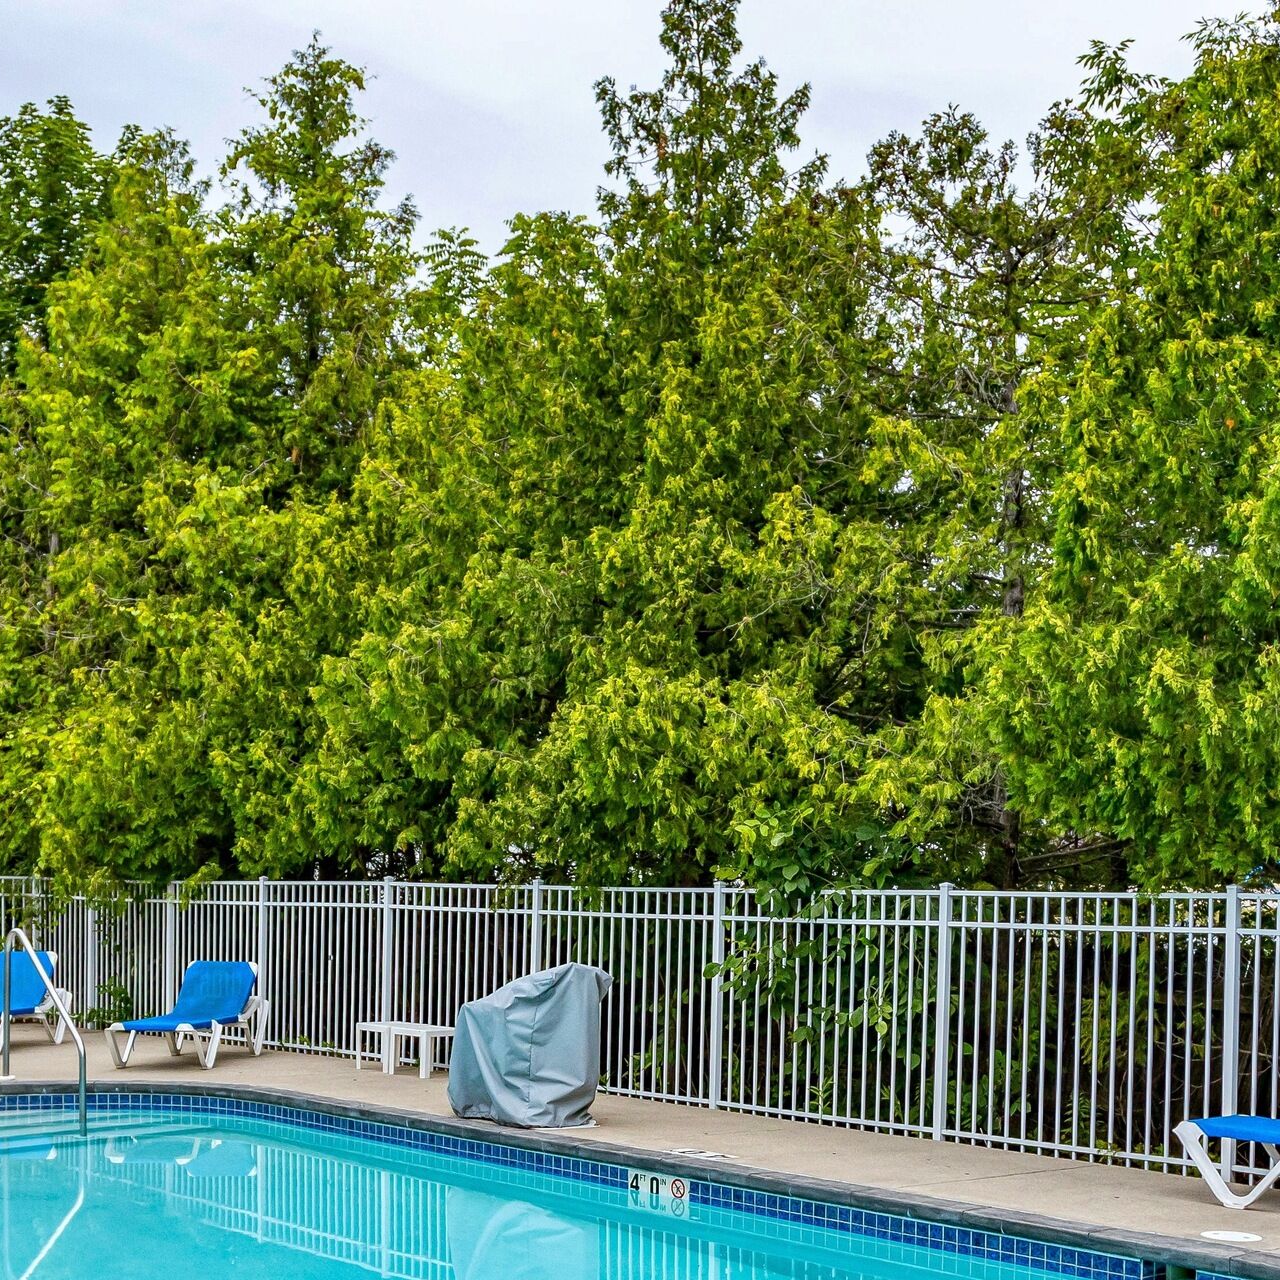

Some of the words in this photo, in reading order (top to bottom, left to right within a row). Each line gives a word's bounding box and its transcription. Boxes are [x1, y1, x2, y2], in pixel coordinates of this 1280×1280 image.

[630, 1173, 640, 1191] 4
[640, 1174, 646, 1182] FT
[649, 1176, 659, 1195] 0
